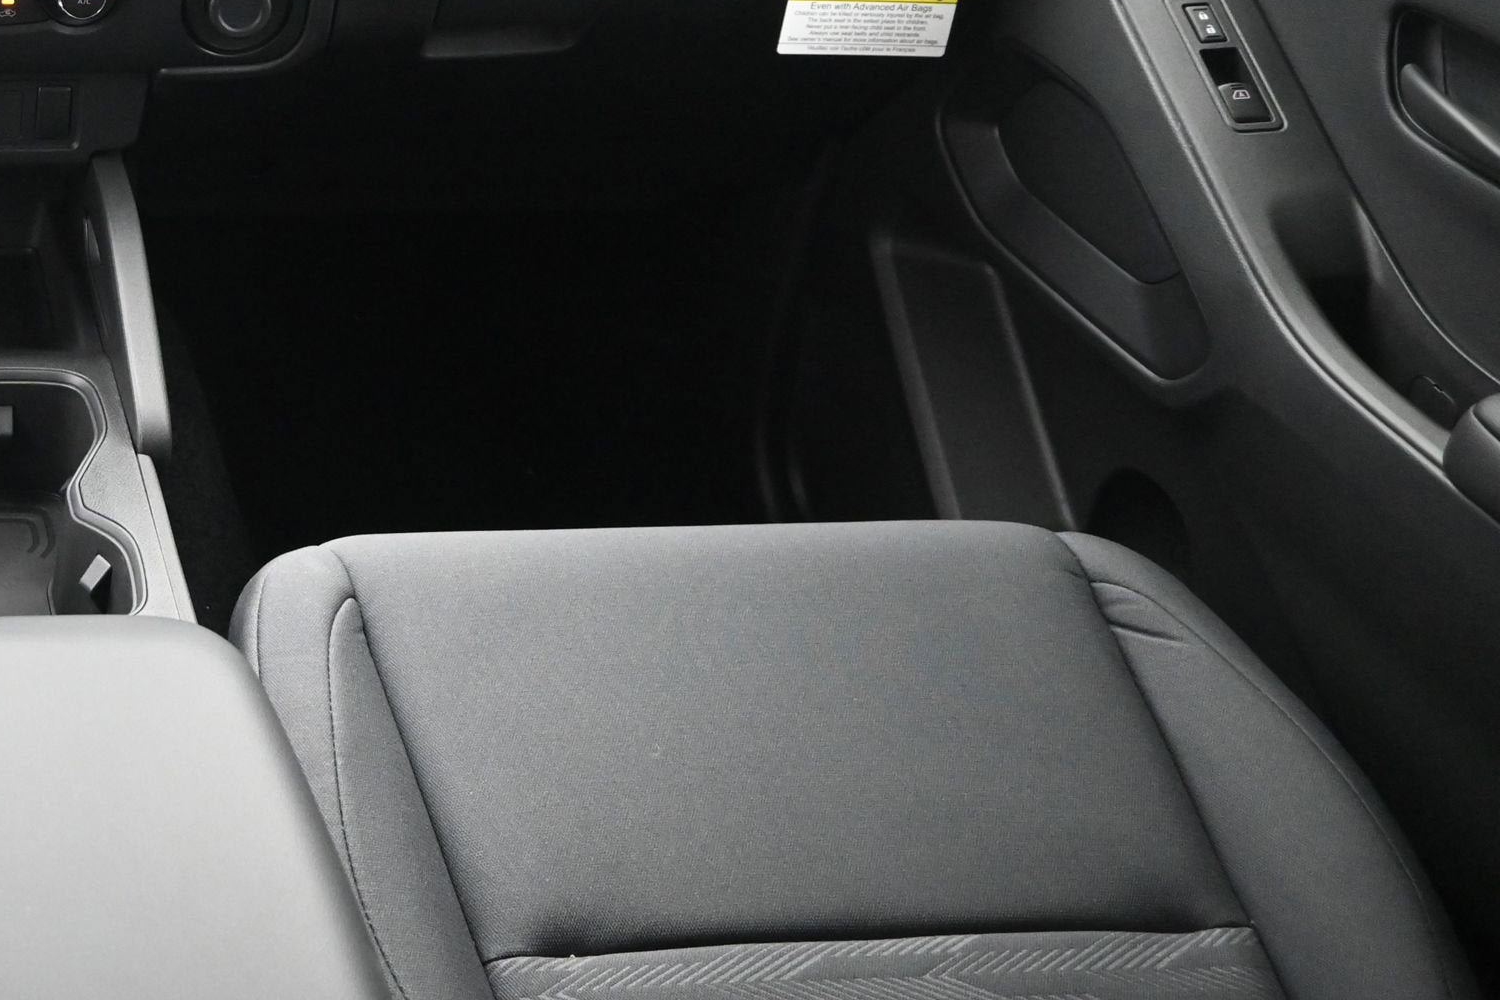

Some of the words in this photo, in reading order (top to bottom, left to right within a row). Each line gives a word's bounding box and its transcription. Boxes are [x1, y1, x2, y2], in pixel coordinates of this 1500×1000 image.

[810, 1, 832, 10] Even
[835, 2, 851, 10] with
[853, 3, 895, 11] Advanced
[911, 4, 933, 13] Bags
